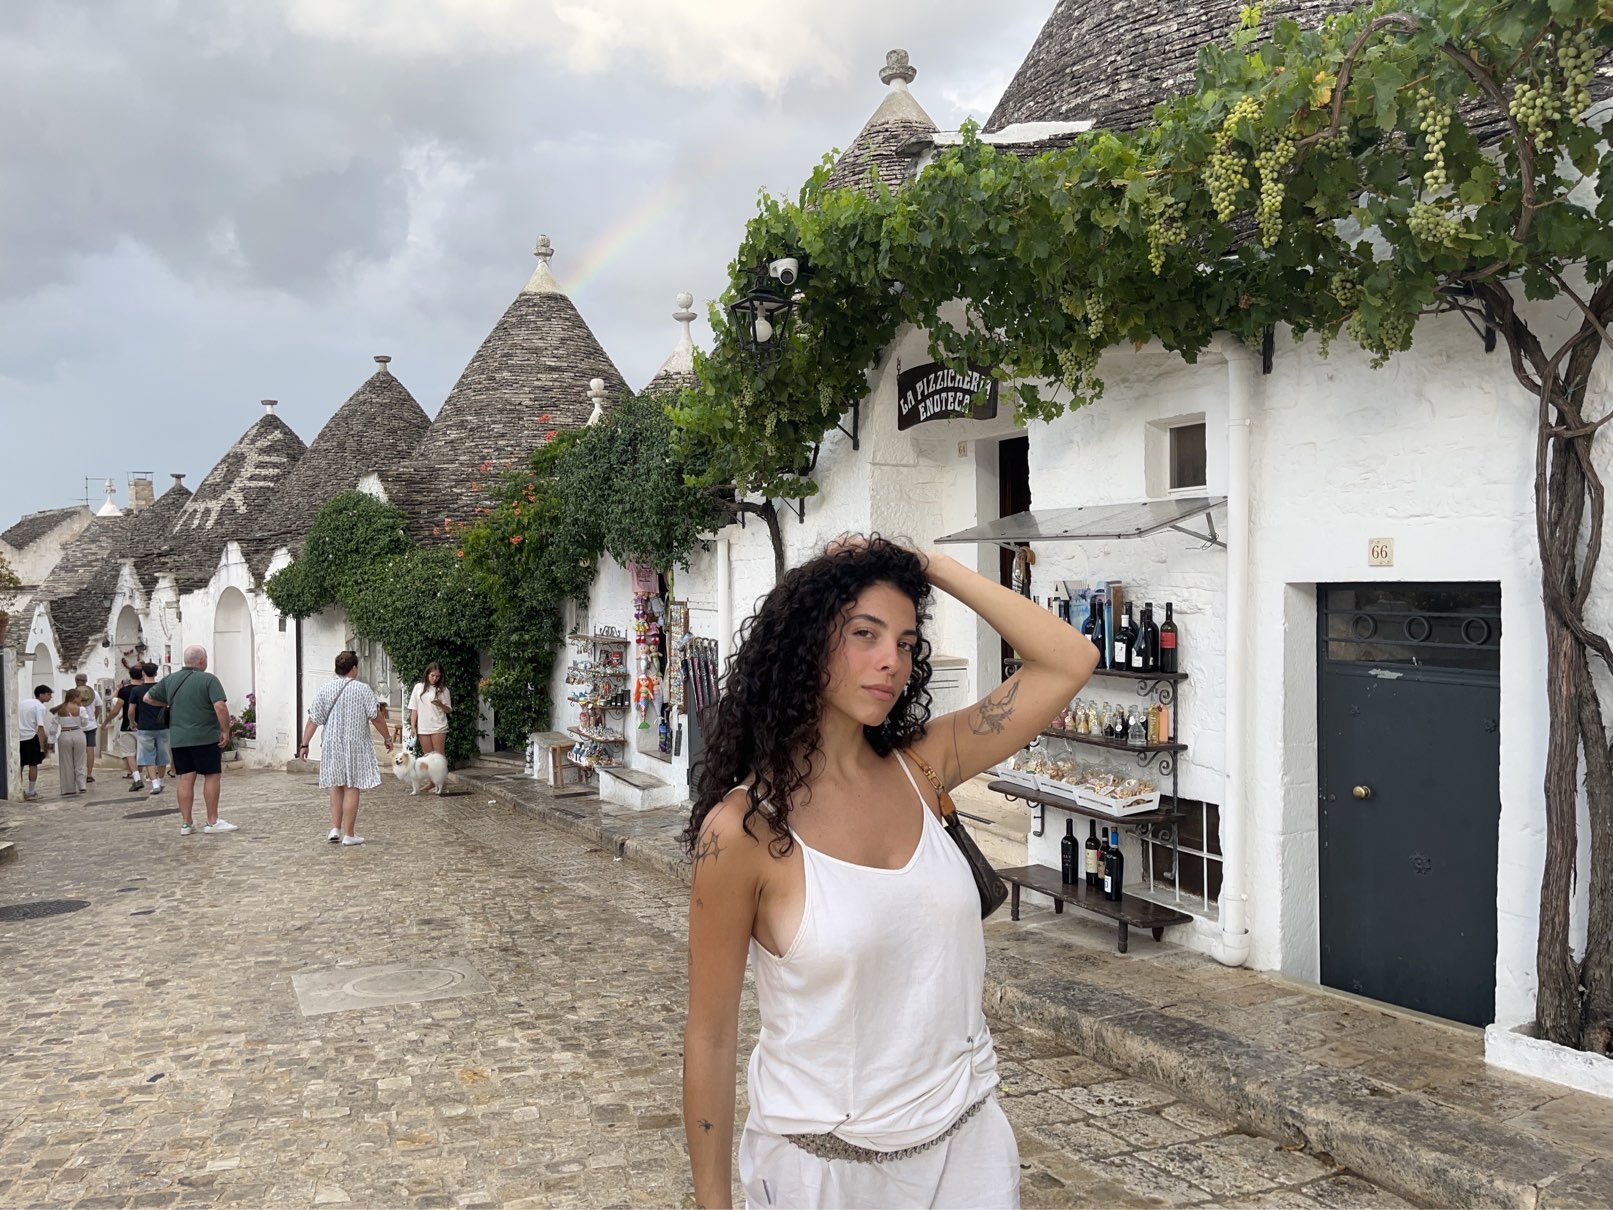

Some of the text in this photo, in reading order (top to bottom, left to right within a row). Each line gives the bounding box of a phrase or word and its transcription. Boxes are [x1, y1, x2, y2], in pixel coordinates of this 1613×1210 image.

[900, 390, 915, 416] LA
[918, 391, 971, 421] ENOTECA
[1371, 544, 1388, 560] 66
